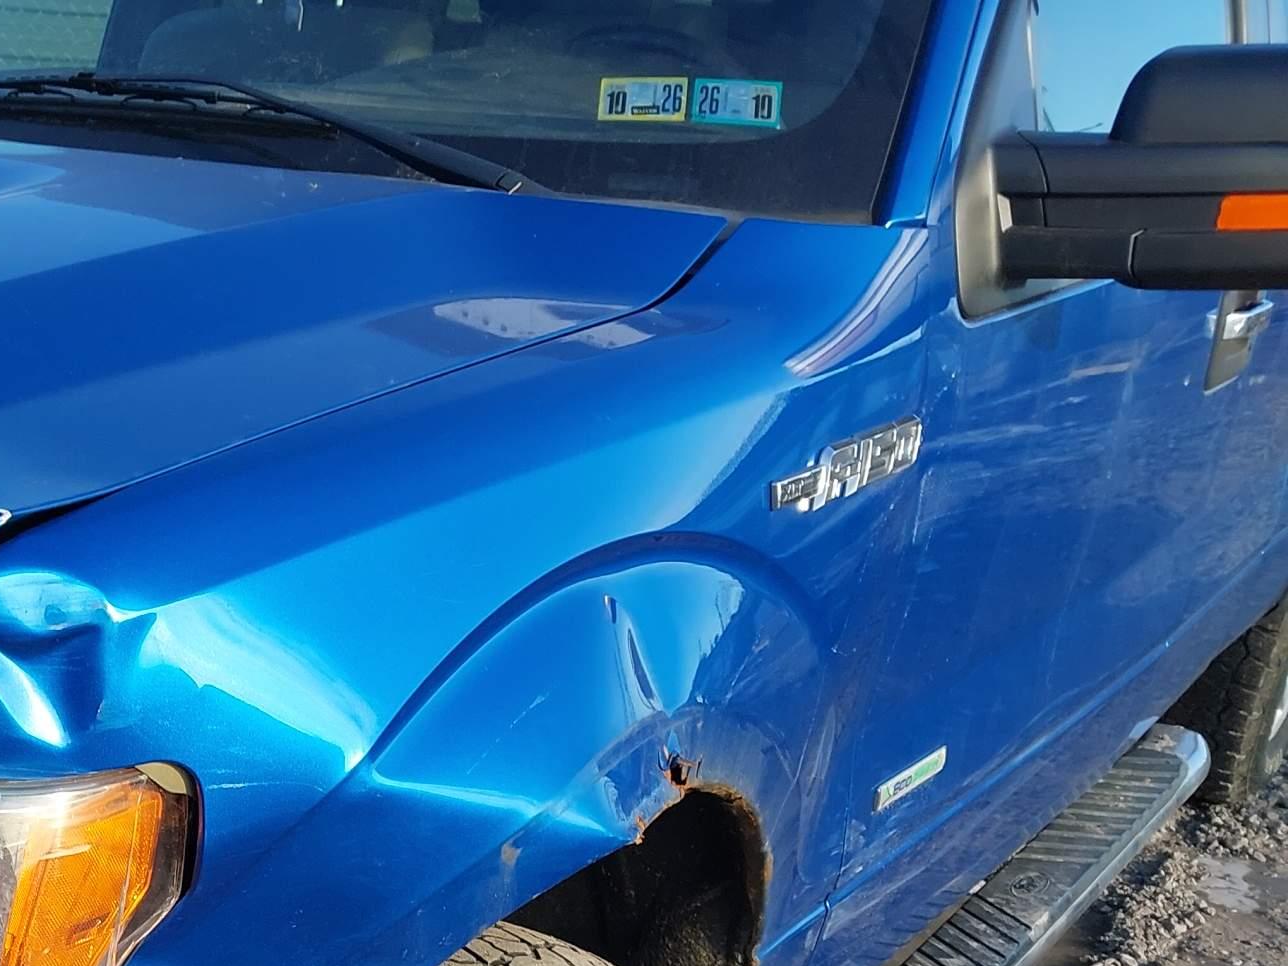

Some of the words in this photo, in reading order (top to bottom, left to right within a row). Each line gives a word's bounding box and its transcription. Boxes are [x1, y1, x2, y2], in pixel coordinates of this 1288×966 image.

[606, 90, 628, 115] 10
[661, 84, 684, 113] 26
[698, 85, 721, 115] 26
[751, 94, 773, 119] 10
